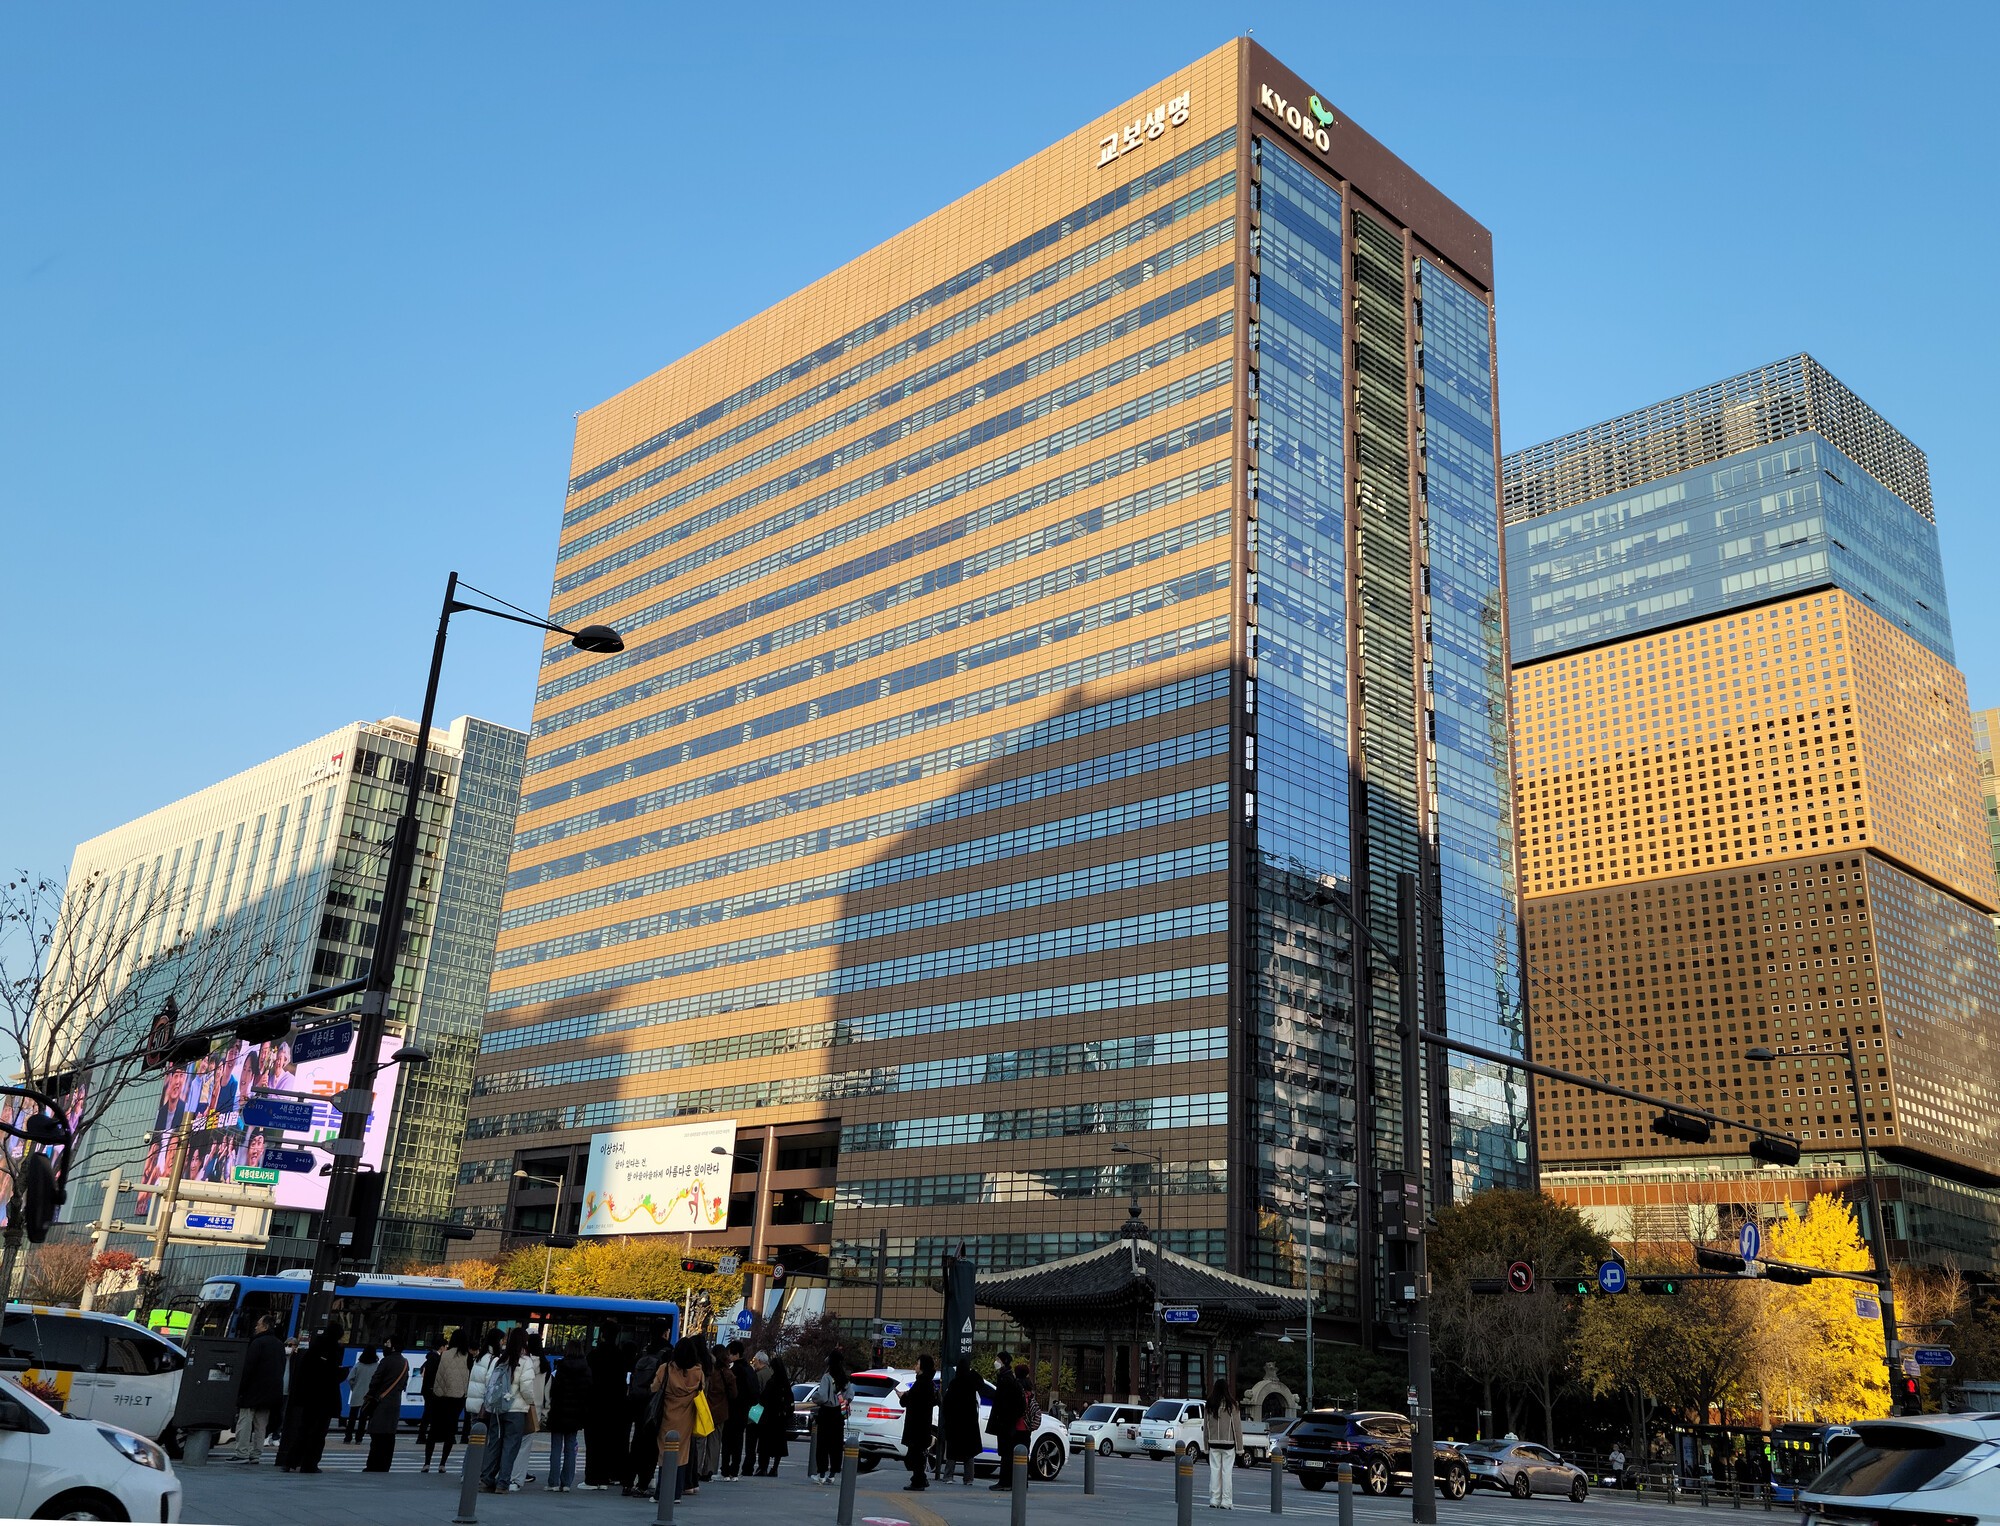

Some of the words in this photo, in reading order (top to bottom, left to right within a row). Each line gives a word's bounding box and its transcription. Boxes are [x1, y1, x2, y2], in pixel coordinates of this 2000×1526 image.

[1261, 83, 1330, 153] KYOBO
[1097, 91, 1191, 168] 교보생명
[310, 1030, 335, 1046] 세종대로
[341, 1031, 350, 1043] 153
[280, 1105, 310, 1115] 새문안로
[272, 1113, 309, 1123] Saemunan-ro
[600, 1141, 626, 1155] 이상하지,
[267, 1151, 283, 1160] 종로
[265, 1161, 287, 1169] Jong-ro
[665, 1165, 692, 1178] 아름다운
[693, 1162, 720, 1177] 일이란다
[239, 1169, 275, 1181] 세종대로사거리
[208, 1216, 233, 1225] 새문안로
[1784, 1440, 1810, 1451] 150
